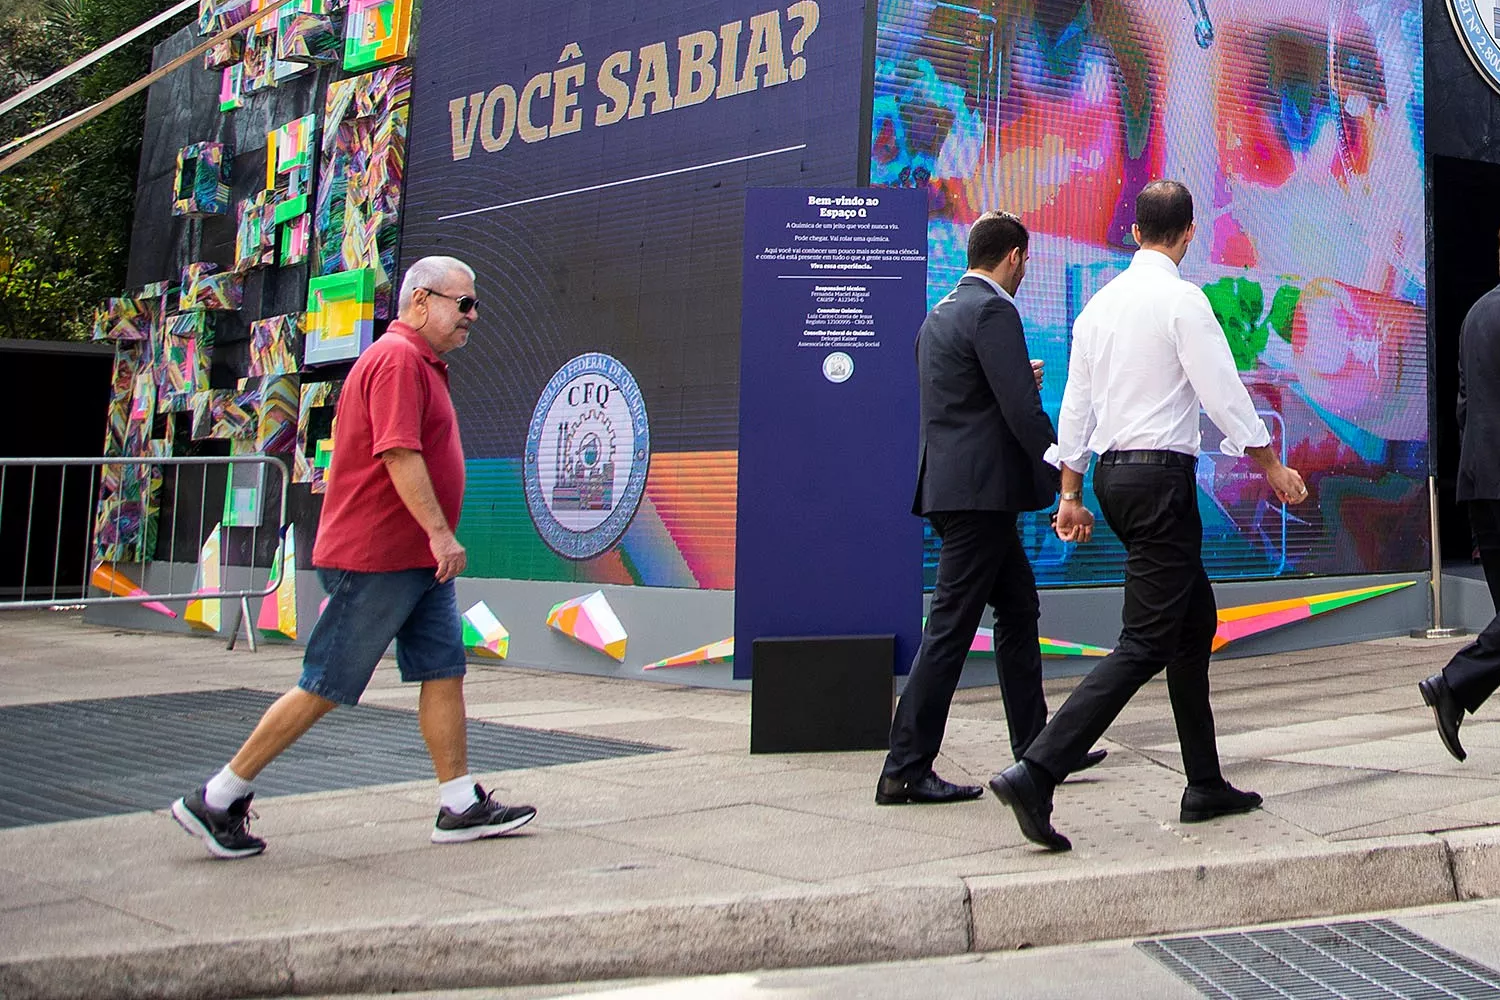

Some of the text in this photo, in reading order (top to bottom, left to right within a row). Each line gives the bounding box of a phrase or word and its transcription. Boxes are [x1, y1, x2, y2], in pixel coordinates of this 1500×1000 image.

[448, 0, 820, 161] VOCÊ SABIA?
[808, 195, 879, 206] Bem-vindo ao
[820, 208, 867, 219] Espaço Q
[809, 235, 828, 243] chegar.
[866, 235, 890, 243] química.
[567, 357, 609, 377] FEDERAL
[608, 359, 622, 381] DE
[568, 382, 610, 409] CFQ
